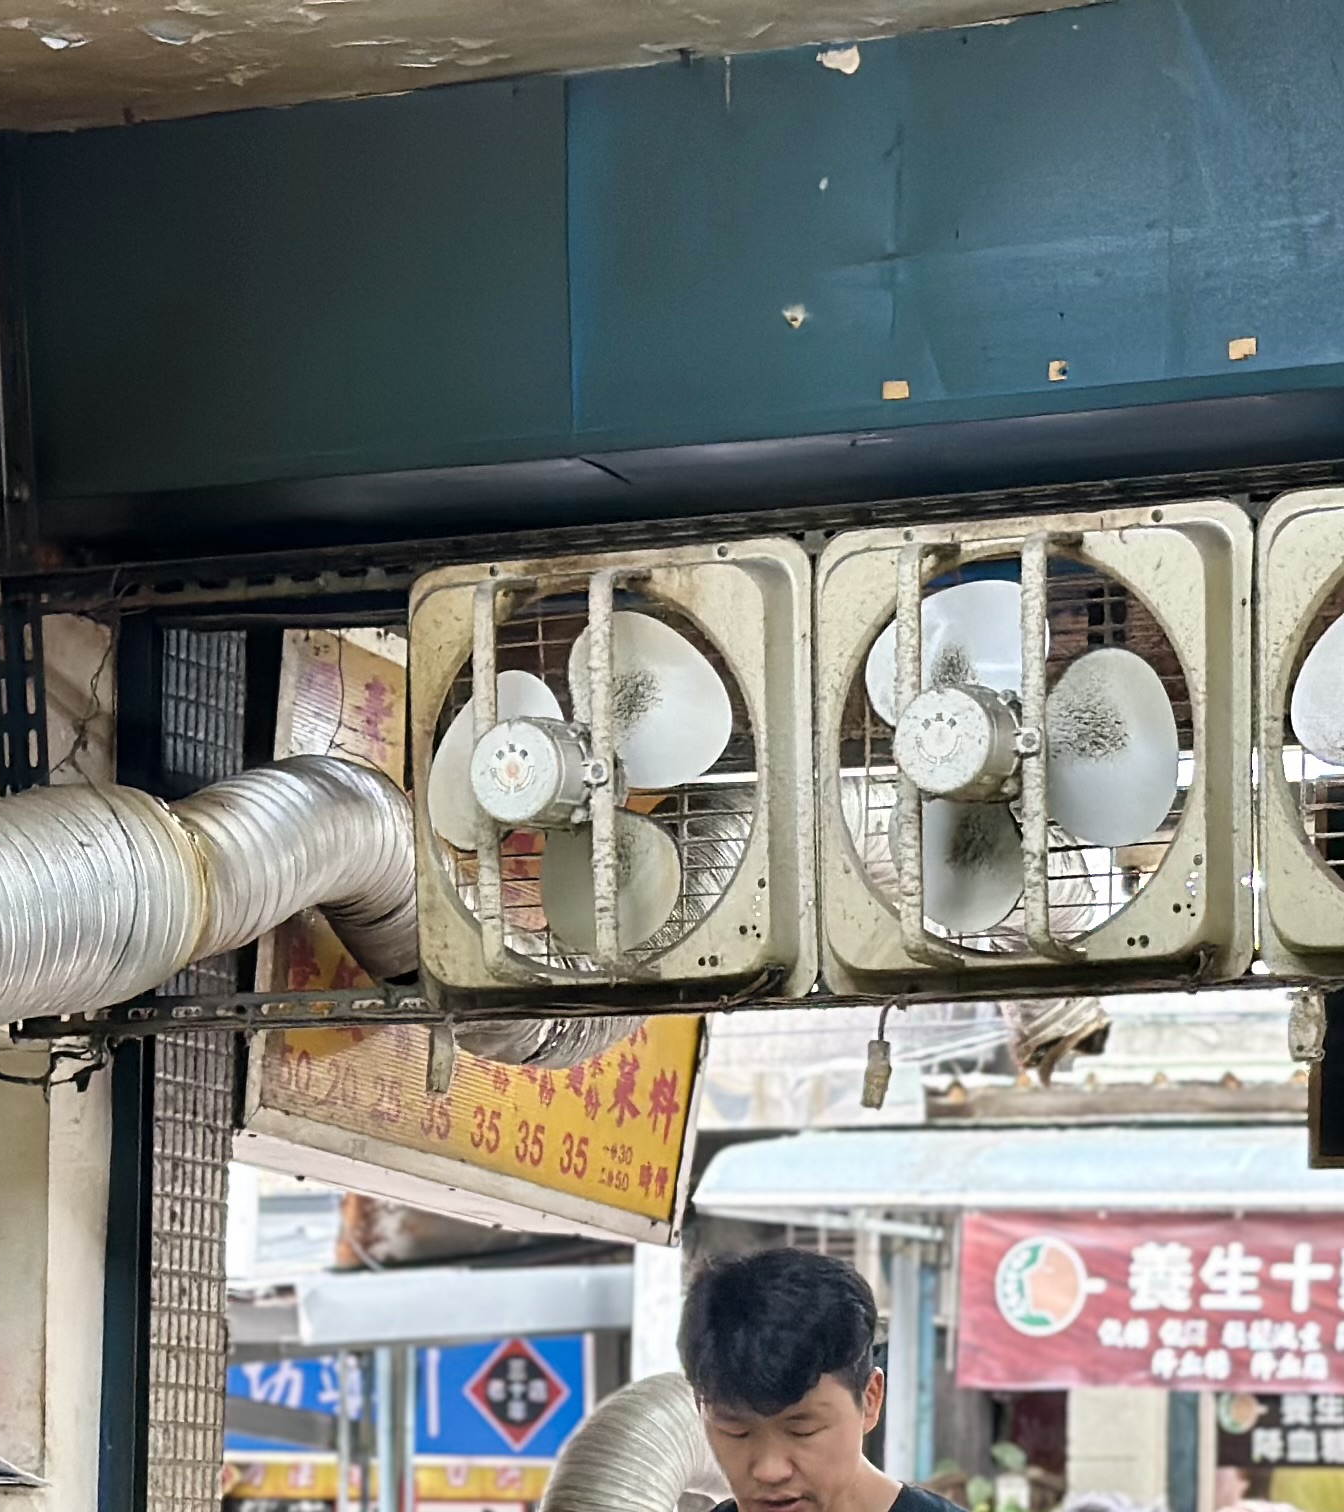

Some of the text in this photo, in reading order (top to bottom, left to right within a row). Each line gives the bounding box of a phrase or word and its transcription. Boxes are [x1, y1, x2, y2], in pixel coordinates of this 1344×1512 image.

[470, 1106, 501, 1154] 35
[515, 1120, 545, 1167] 35
[560, 1132, 590, 1179] 35
